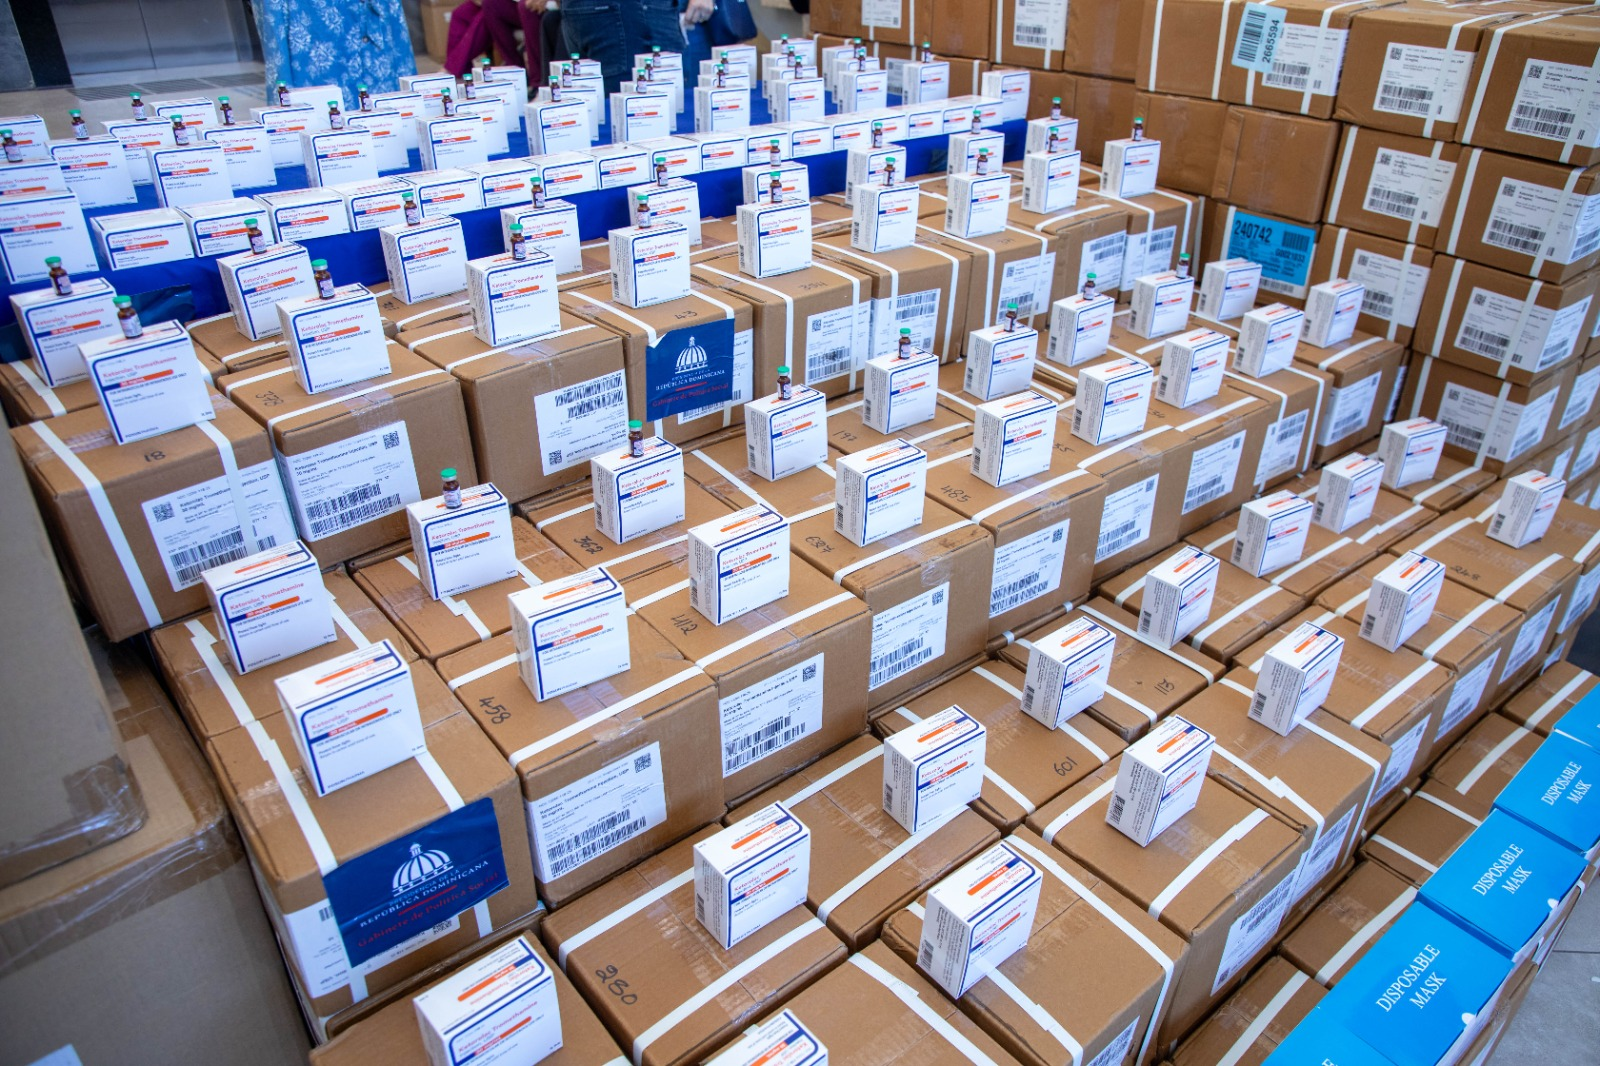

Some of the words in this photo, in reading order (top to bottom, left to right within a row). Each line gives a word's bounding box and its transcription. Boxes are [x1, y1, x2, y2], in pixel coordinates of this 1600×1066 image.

[1262, 19, 1280, 64] 2665594
[1234, 220, 1272, 243] 240742
[689, 370, 725, 382] DOMINICANA
[144, 450, 166, 463] 18
[940, 485, 971, 503] 485
[581, 536, 603, 554] 362
[230, 596, 259, 610] Ketorolac
[261, 582, 303, 599] Tromethamine
[311, 712, 344, 729] Ketorolac
[346, 692, 392, 715] Tromethamine
[479, 696, 511, 724] 458
[1054, 756, 1078, 776] 601
[1540, 761, 1582, 806] DISPOSABLE
[1566, 780, 1592, 804] MASK
[1472, 843, 1524, 896] DISPOSABLE
[1501, 865, 1532, 895] MASK
[358, 918, 409, 947] Gabinete
[411, 912, 423, 921] de
[468, 872, 499, 892] Social
[360, 894, 419, 928] REPÚBLICA
[423, 860, 488, 897] DOMINICANA
[595, 965, 638, 1005] 280
[1375, 944, 1440, 1012] DISPOSABLE
[1409, 970, 1447, 1010] MASK
[459, 1028, 490, 1051] Ketorolac
[492, 1000, 536, 1031] Tromethamine
